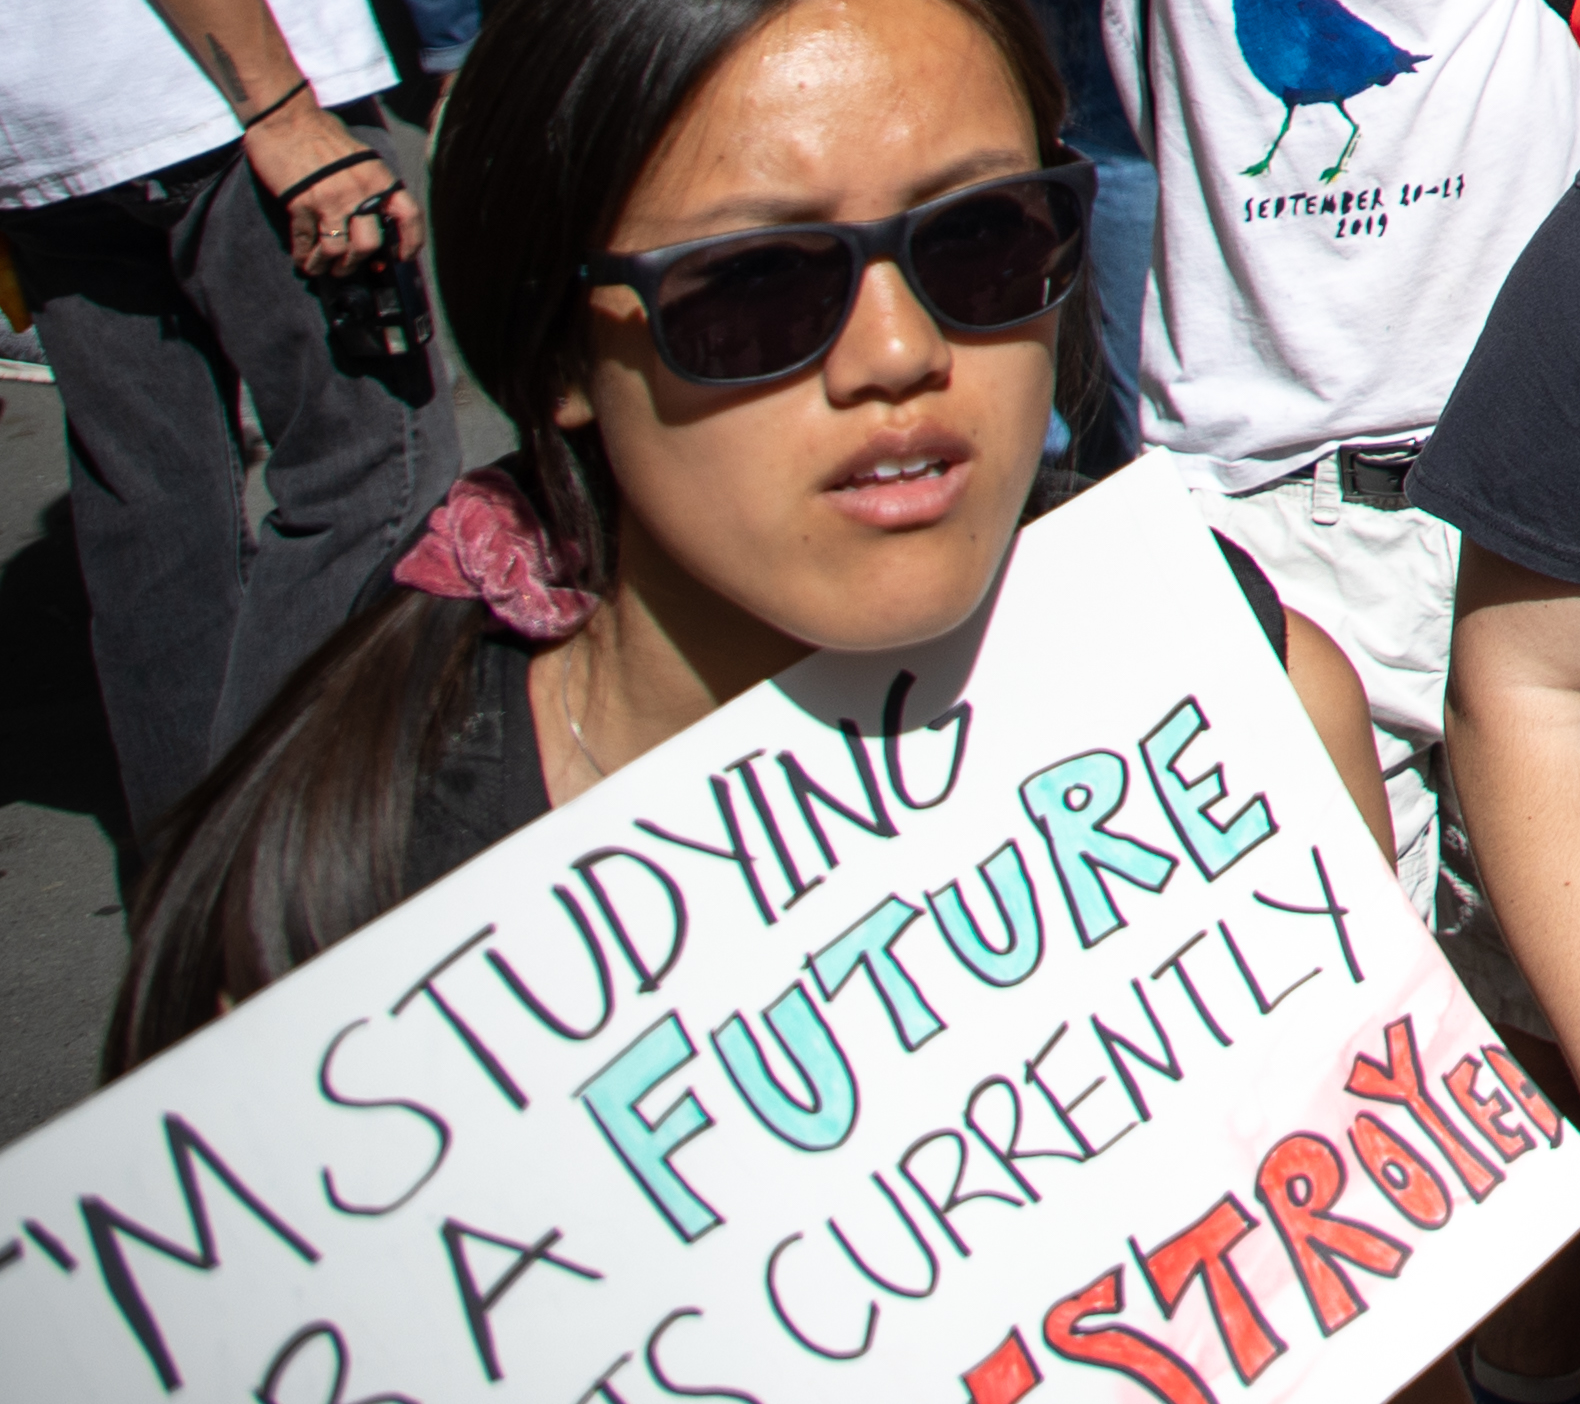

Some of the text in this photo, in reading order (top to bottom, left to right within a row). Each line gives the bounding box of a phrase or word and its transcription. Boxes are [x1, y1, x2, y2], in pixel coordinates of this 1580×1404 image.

[1245, 187, 1384, 222] SEPTEMBER
[1335, 213, 1388, 238] 2019
[317, 671, 971, 1216] STUDYING
[440, 695, 1279, 1383] A FUTURE
[767, 846, 1366, 1359] CURRENTLY
